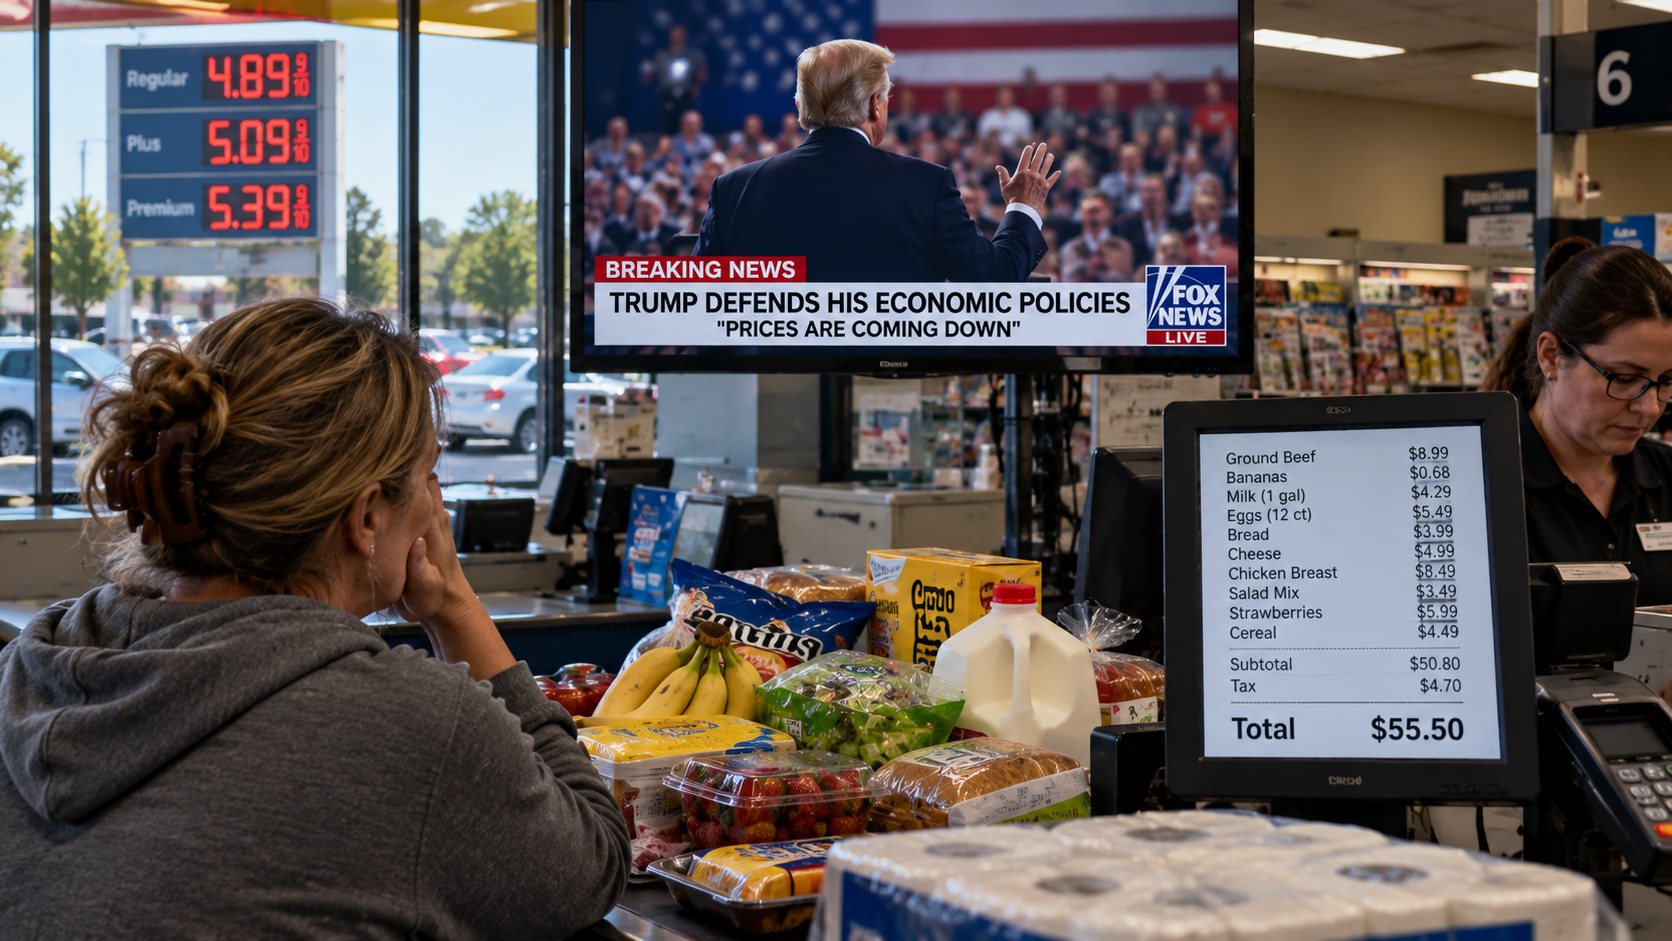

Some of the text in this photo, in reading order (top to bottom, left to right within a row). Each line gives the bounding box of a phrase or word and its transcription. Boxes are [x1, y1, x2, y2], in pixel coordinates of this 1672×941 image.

[127, 69, 188, 91] Regular
[208, 53, 290, 99] 4.89
[1597, 50, 1632, 106] 6
[127, 135, 161, 152] Plus
[208, 119, 290, 165] 5.09
[127, 199, 195, 217] Premium
[208, 184, 290, 230] 5.39
[606, 260, 796, 279] BREAKING NEWS
[610, 291, 1131, 314] TRUMP DEFENDS HIS ECONOMIC POLICIES
[1173, 284, 1221, 305] FOX
[1158, 306, 1222, 326] NEWS
[717, 319, 1021, 338] "PRICES ARE COMING DOWN"
[1165, 331, 1207, 344] LIVE
[1226, 446, 1449, 465] Ground Beef $8.99
[1226, 465, 1450, 484] Bananas $0.68
[1227, 484, 1452, 505] Milk (1 gal) $4.29
[1228, 504, 1453, 525] Eggs (12 ct) $5.49
[1228, 523, 1454, 541] Bread $3.99
[1228, 543, 1455, 560] Cheese $4.99
[1229, 563, 1456, 580] Chicken Breast $8.49
[1229, 583, 1457, 600] Salad Mix $3.49
[1229, 603, 1458, 620] Strawberries $5.99
[1230, 623, 1459, 640] Cereal $4.49
[1230, 656, 1461, 673] Subtotal $50.80
[1230, 677, 1462, 694] Tax $4.70
[1231, 714, 1464, 744] Total $55.50
